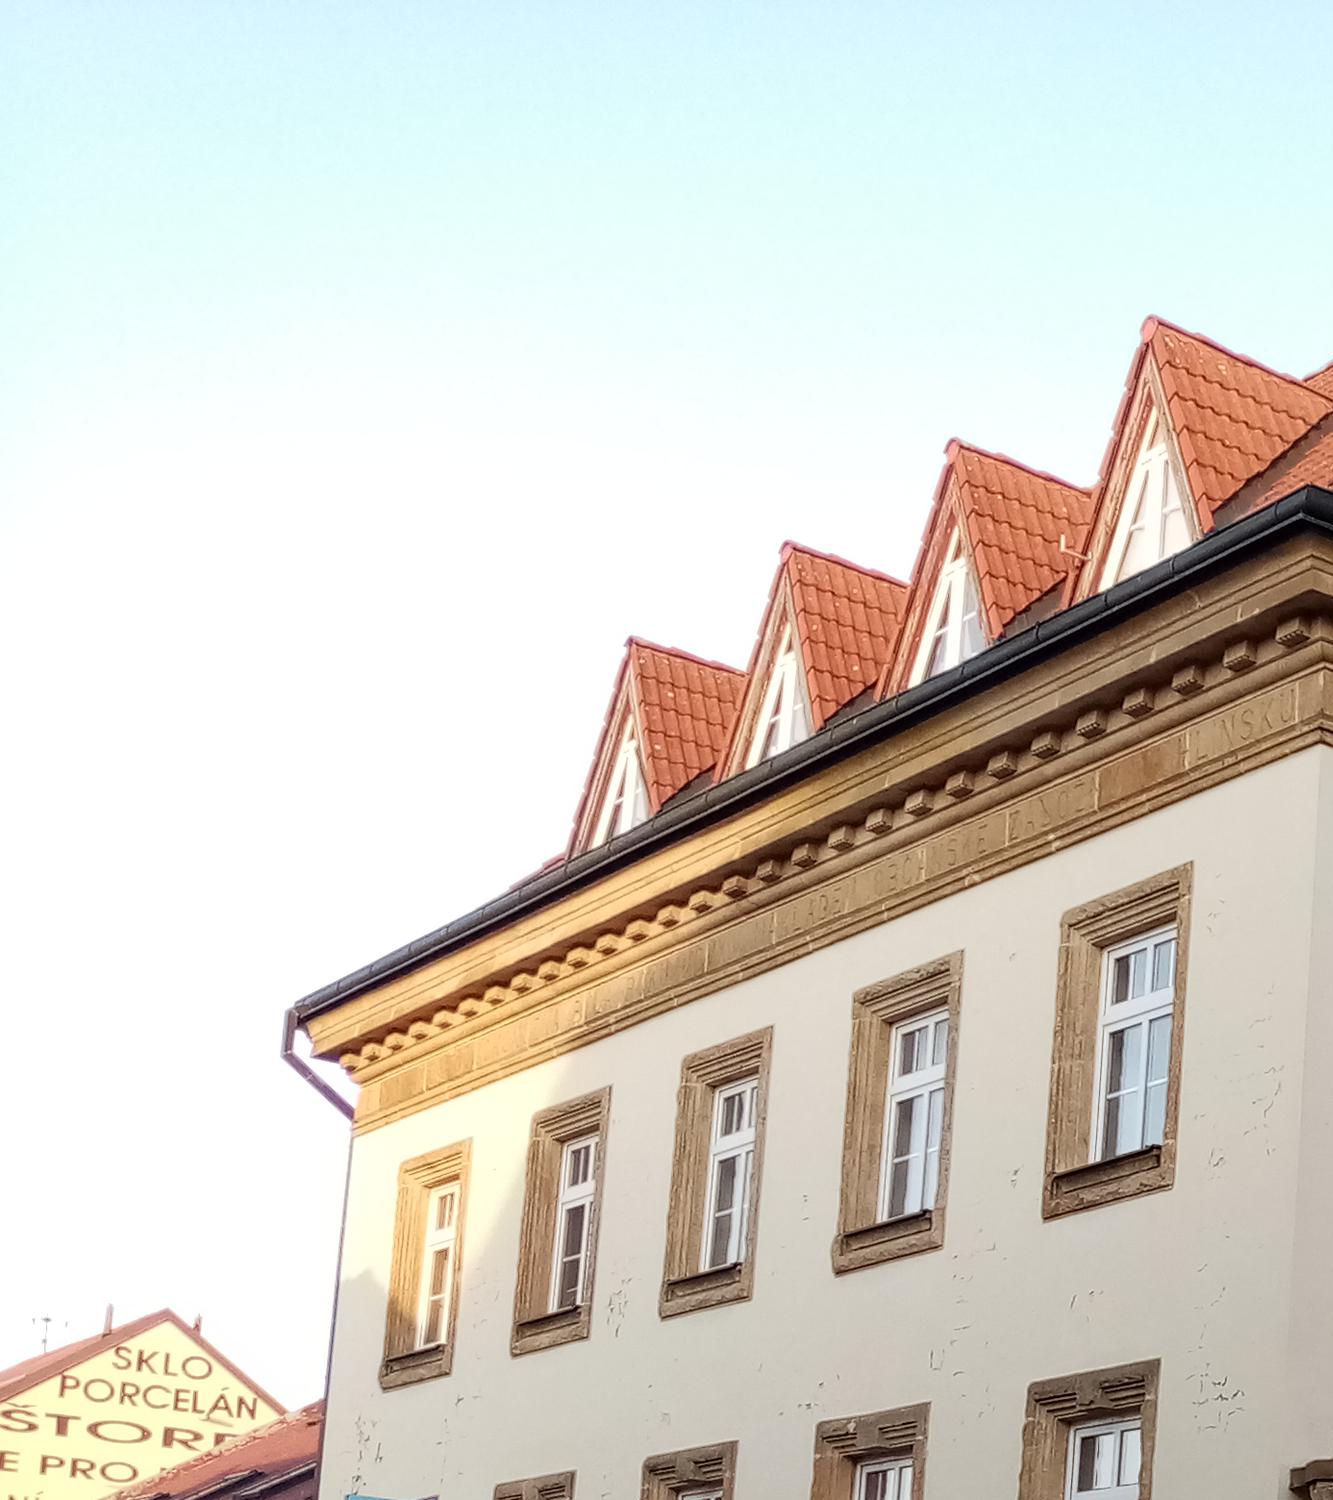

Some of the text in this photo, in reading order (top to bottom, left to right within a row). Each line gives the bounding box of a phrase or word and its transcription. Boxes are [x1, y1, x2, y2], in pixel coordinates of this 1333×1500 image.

[111, 1345, 214, 1381] SKLO
[58, 1373, 260, 1422] PORCELÁN
[39, 1453, 139, 1484] PRO
